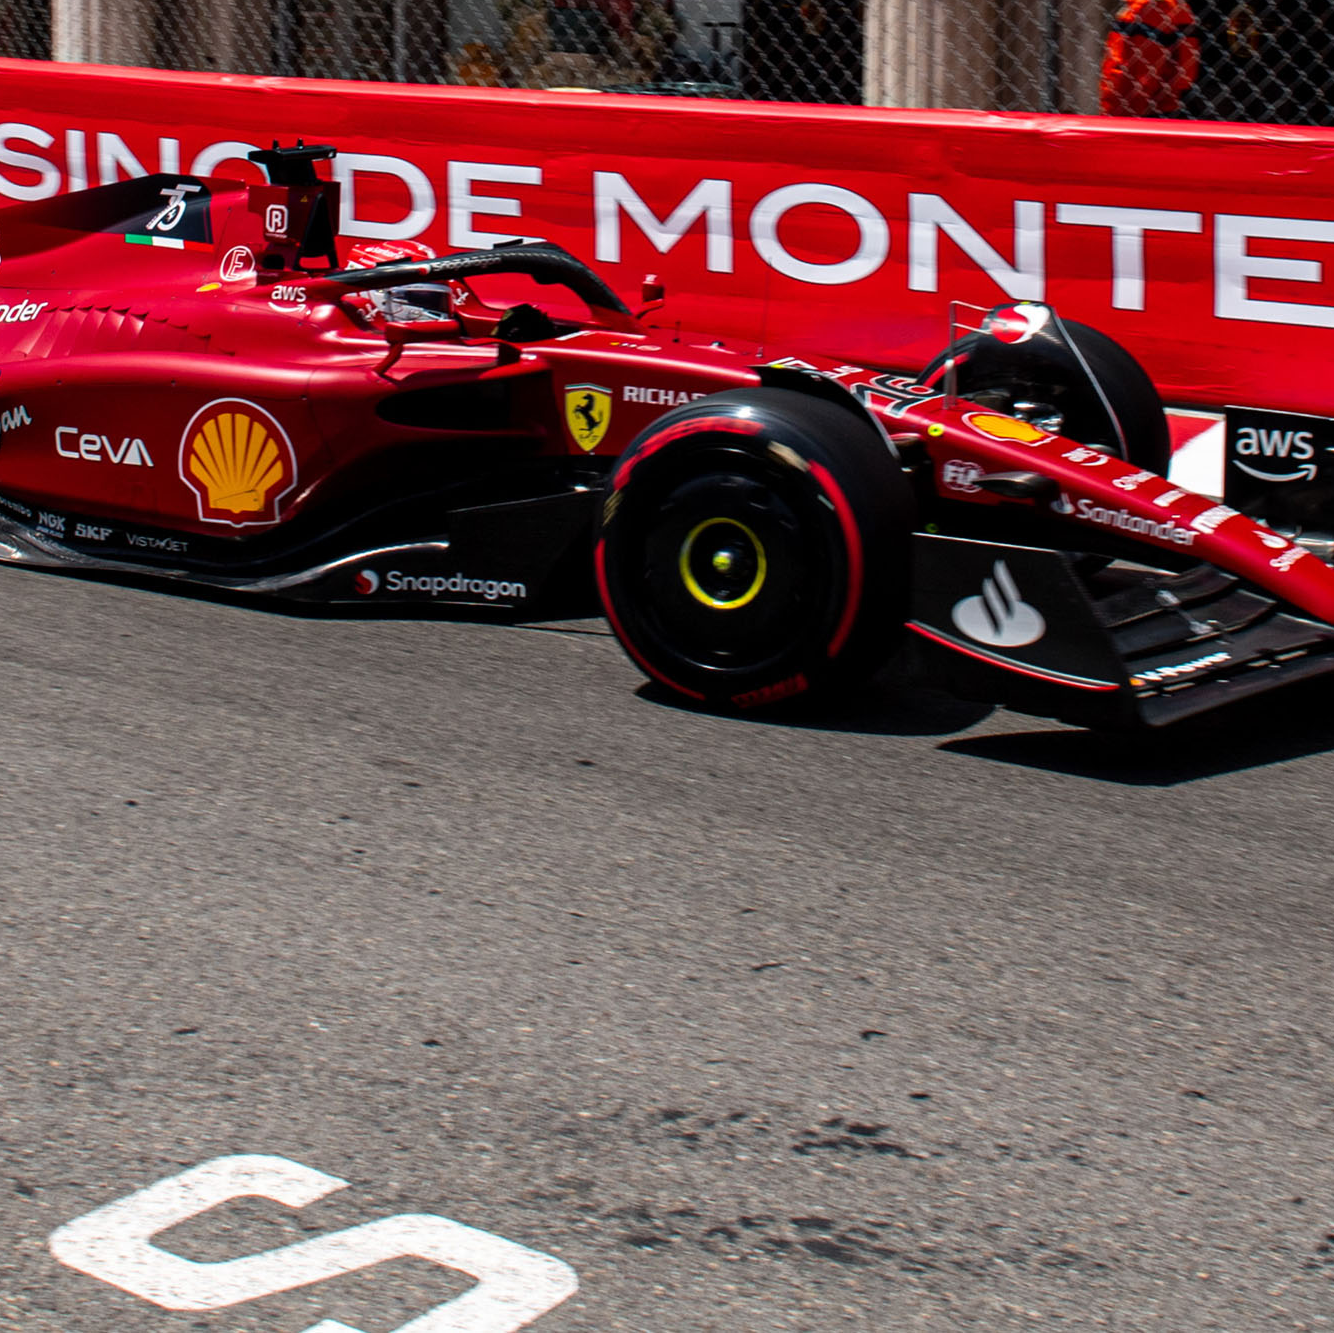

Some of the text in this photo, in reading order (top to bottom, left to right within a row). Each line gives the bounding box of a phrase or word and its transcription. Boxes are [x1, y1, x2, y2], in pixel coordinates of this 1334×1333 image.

[331, 151, 548, 250] DE
[271, 284, 307, 303] aws
[1235, 427, 1315, 460] aws
[38, 511, 66, 532] NGK
[75, 523, 113, 541] SKF
[1075, 498, 1200, 545] Santander
[386, 570, 526, 600] Snapdragon
